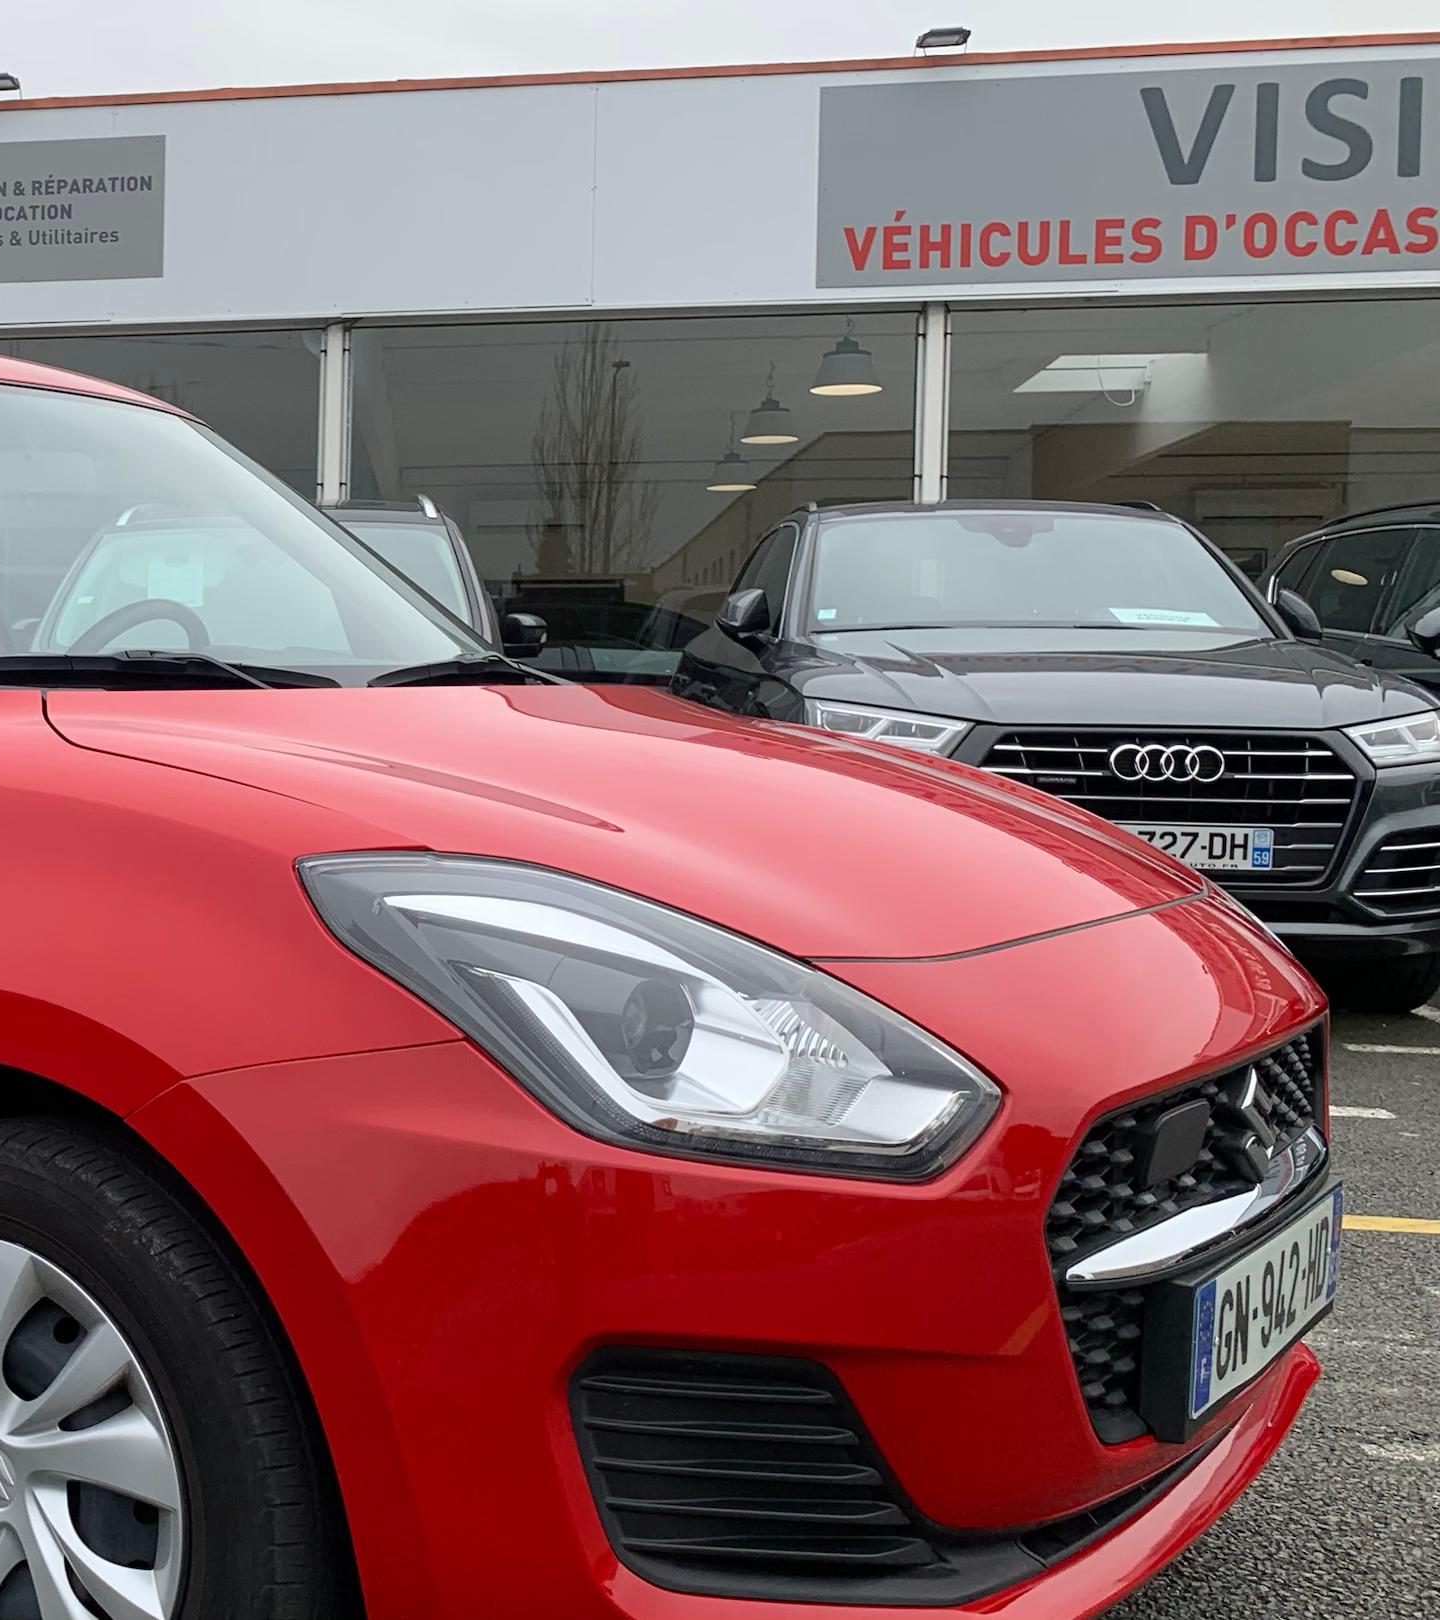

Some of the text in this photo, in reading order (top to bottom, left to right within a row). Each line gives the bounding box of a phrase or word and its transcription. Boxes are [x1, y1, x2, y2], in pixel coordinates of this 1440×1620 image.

[13, 181, 25, 196] &
[31, 174, 153, 196] RÉPARATION
[9, 231, 22, 247] &
[28, 228, 120, 246] Utilitaires
[843, 210, 1163, 271] VÉHICULES
[1253, 850, 1269, 865] 59
[1216, 1216, 1329, 1381] GN-942-HD
